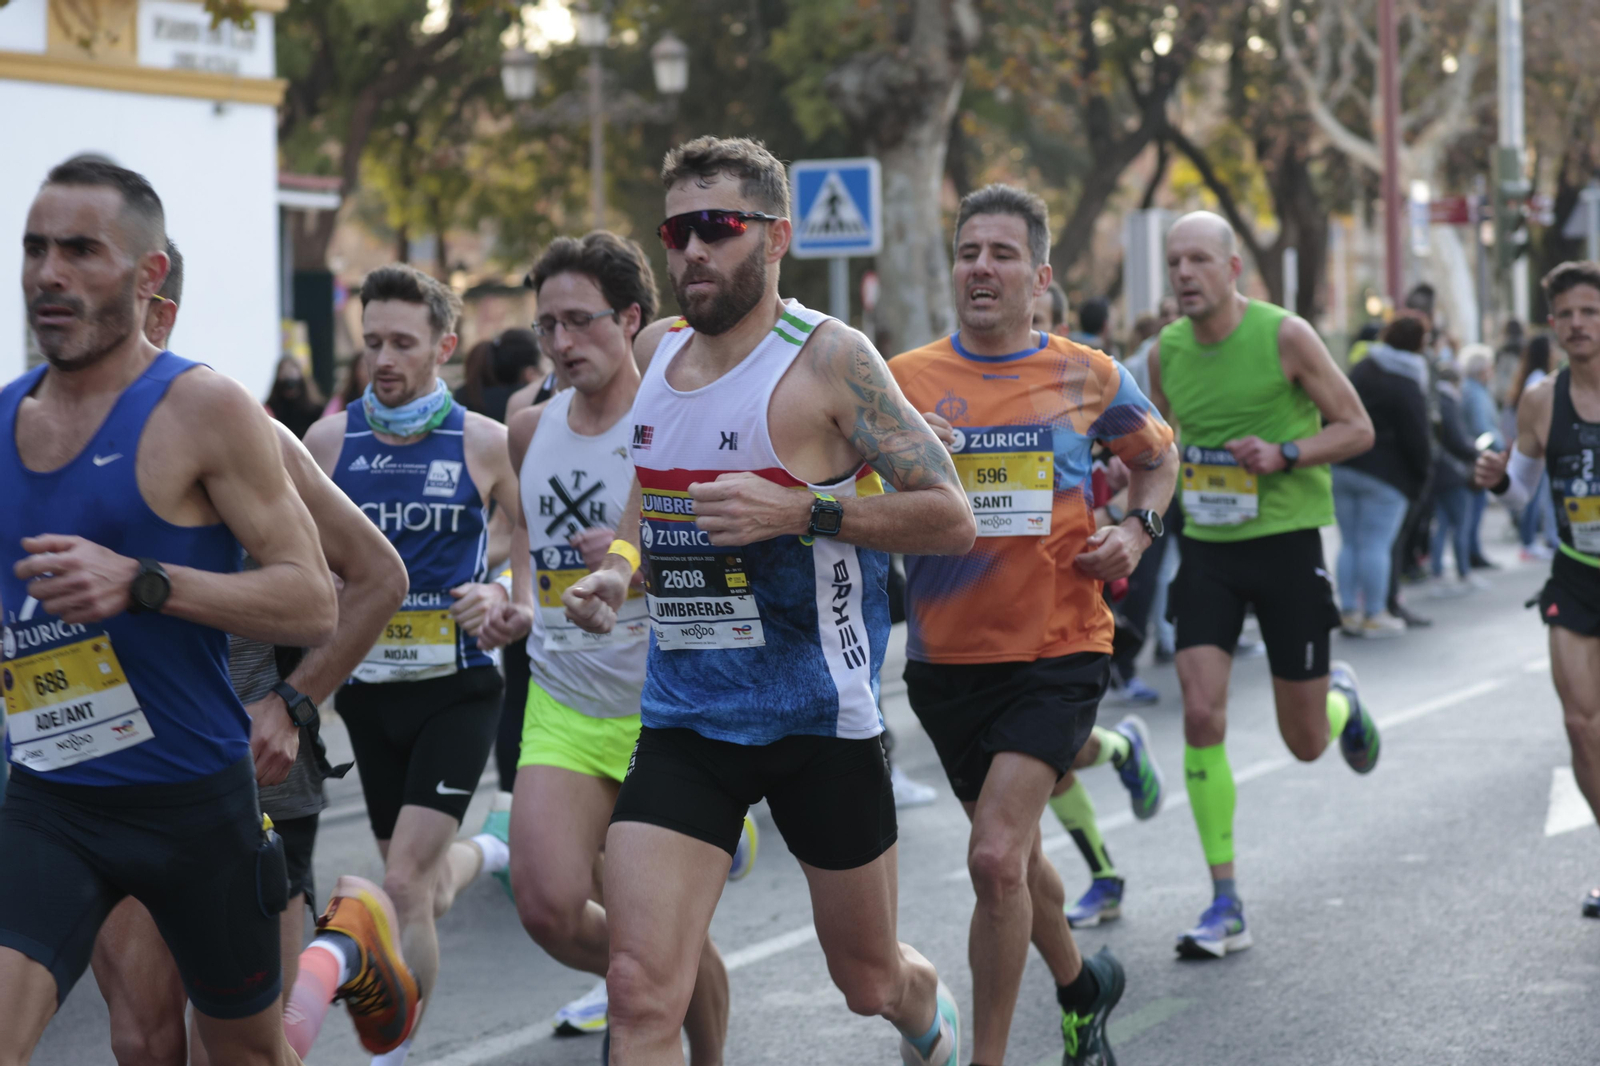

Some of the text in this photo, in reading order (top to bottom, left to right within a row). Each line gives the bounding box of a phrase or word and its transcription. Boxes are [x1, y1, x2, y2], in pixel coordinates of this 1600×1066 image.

[970, 432, 1038, 448] ZURICH
[977, 467, 1007, 484] 596
[973, 496, 1012, 509] SANTI
[656, 530, 714, 547] ZURIC
[662, 570, 705, 589] 2608
[386, 624, 412, 639] 532
[34, 669, 69, 696] 688
[35, 701, 95, 732] ADE/ANT
